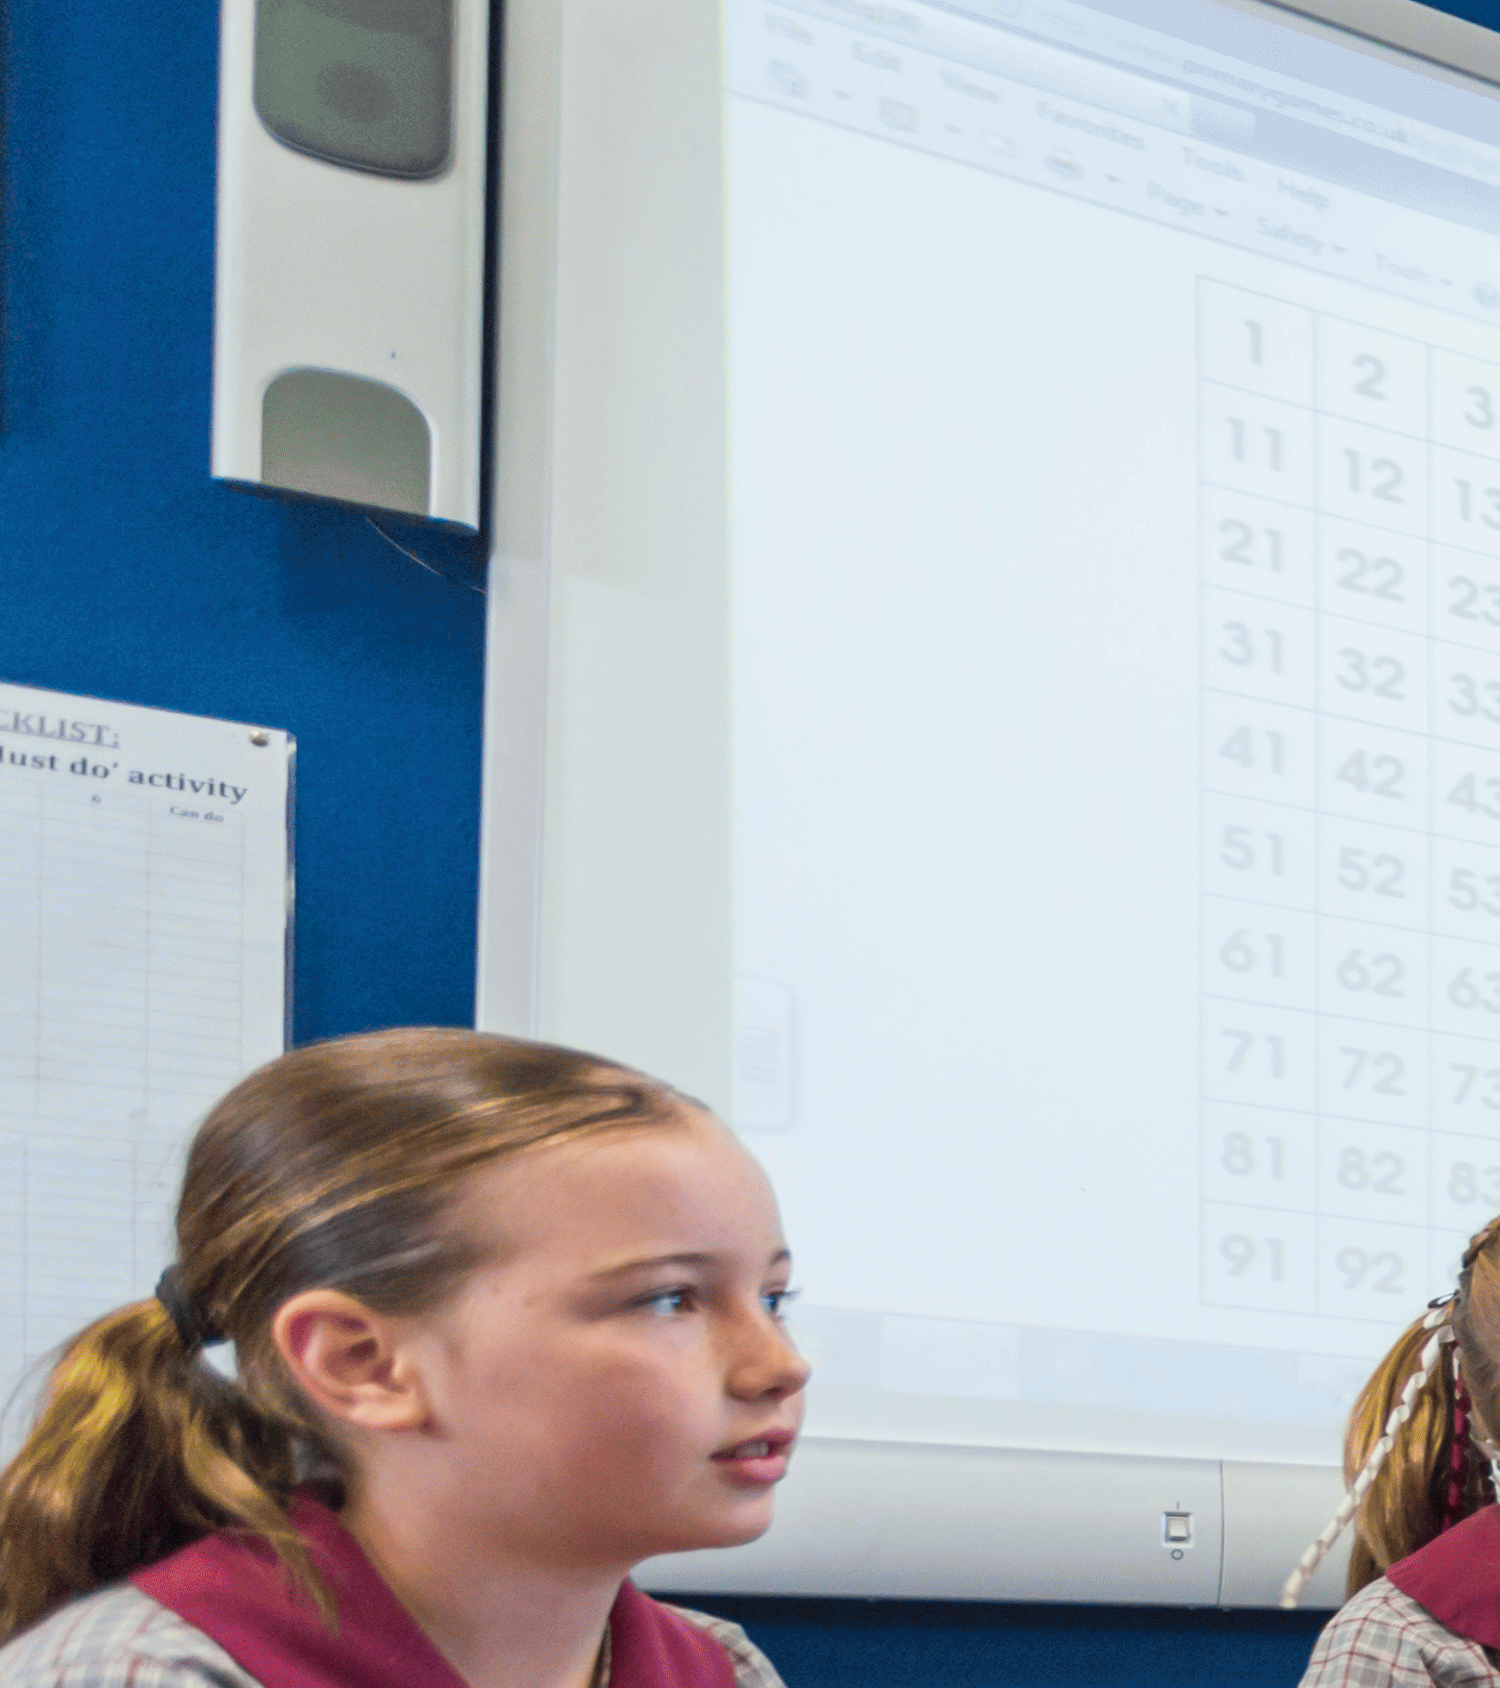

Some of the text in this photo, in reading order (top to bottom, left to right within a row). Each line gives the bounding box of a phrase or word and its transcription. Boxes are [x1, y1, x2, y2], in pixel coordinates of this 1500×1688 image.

[1243, 318, 1266, 367] 1
[1352, 352, 1388, 402] 2
[1463, 384, 1497, 431] 3
[1226, 415, 1285, 473] 11
[1342, 447, 1406, 505] 12
[1218, 517, 1285, 575] 21
[1335, 546, 1406, 604] 22
[1218, 618, 1286, 675] 31
[1335, 645, 1407, 703] 32
[127, 769, 249, 806] activity
[1218, 724, 1286, 777] 41
[1333, 748, 1407, 801] 42
[1219, 823, 1286, 877] 51
[1336, 846, 1407, 900] 52
[1219, 927, 1285, 979] 61
[1335, 947, 1406, 999] 62
[1222, 1027, 1286, 1080] 71
[1338, 1046, 1406, 1097] 72
[1220, 1130, 1286, 1182] 81
[1336, 1145, 1406, 1197] 82
[1219, 1233, 1286, 1283] 91
[1335, 1246, 1406, 1296] 92
